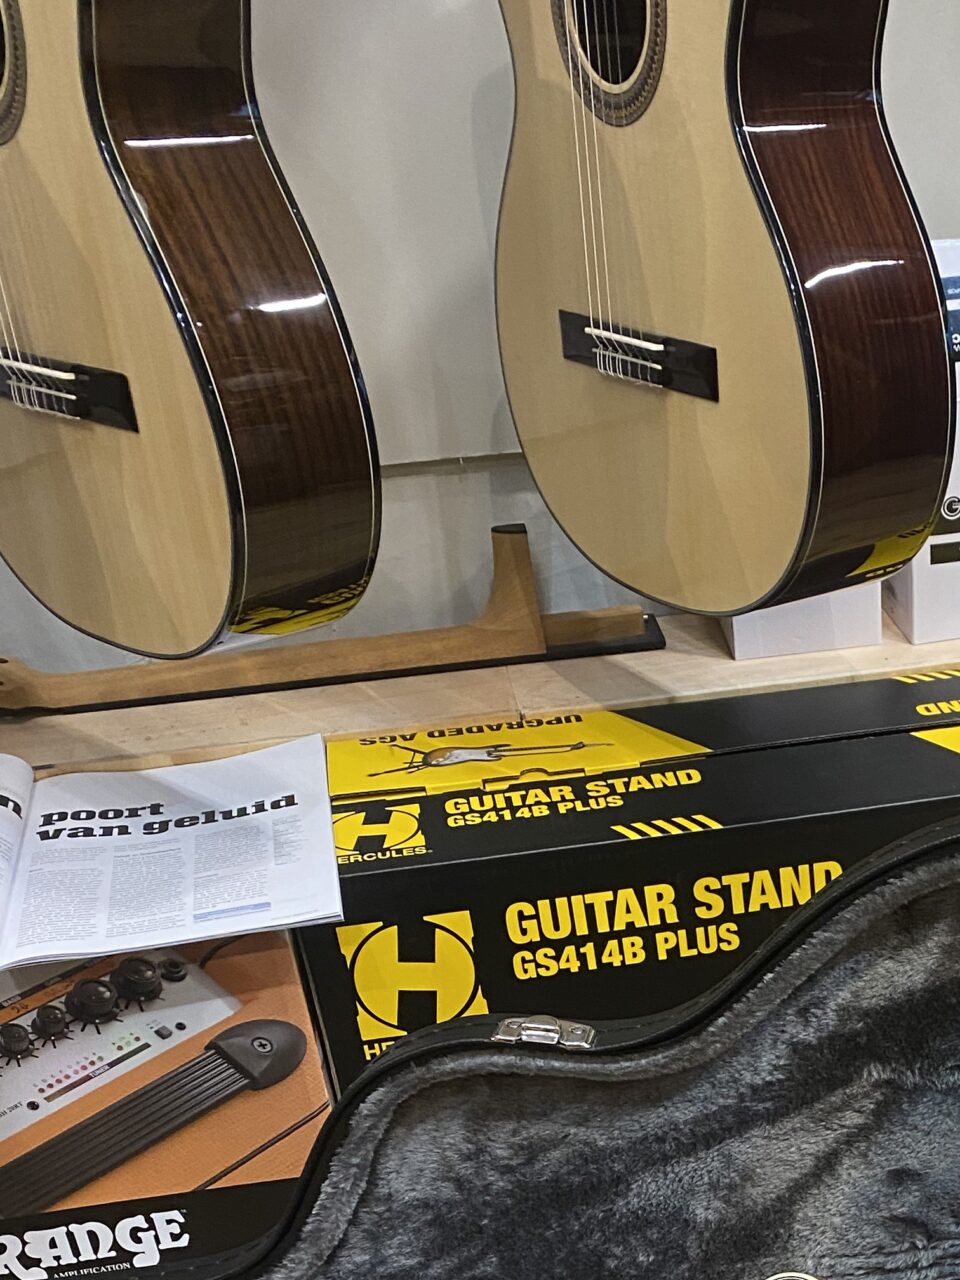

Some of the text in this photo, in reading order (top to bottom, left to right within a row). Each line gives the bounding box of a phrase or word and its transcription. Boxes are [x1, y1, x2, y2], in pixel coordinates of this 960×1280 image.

[358, 714, 583, 746] UPGRADED AGS
[444, 768, 702, 815] GUITAR STAND
[36, 793, 298, 841] van geluid
[38, 801, 164, 827] poort
[446, 795, 624, 828] GS414B PLUS
[337, 846, 427, 864] ERCULES
[505, 883, 680, 945] GUITAR
[512, 922, 740, 980] GS414B PLUS
[53, 1262, 131, 1279] AMPLIFICATION
